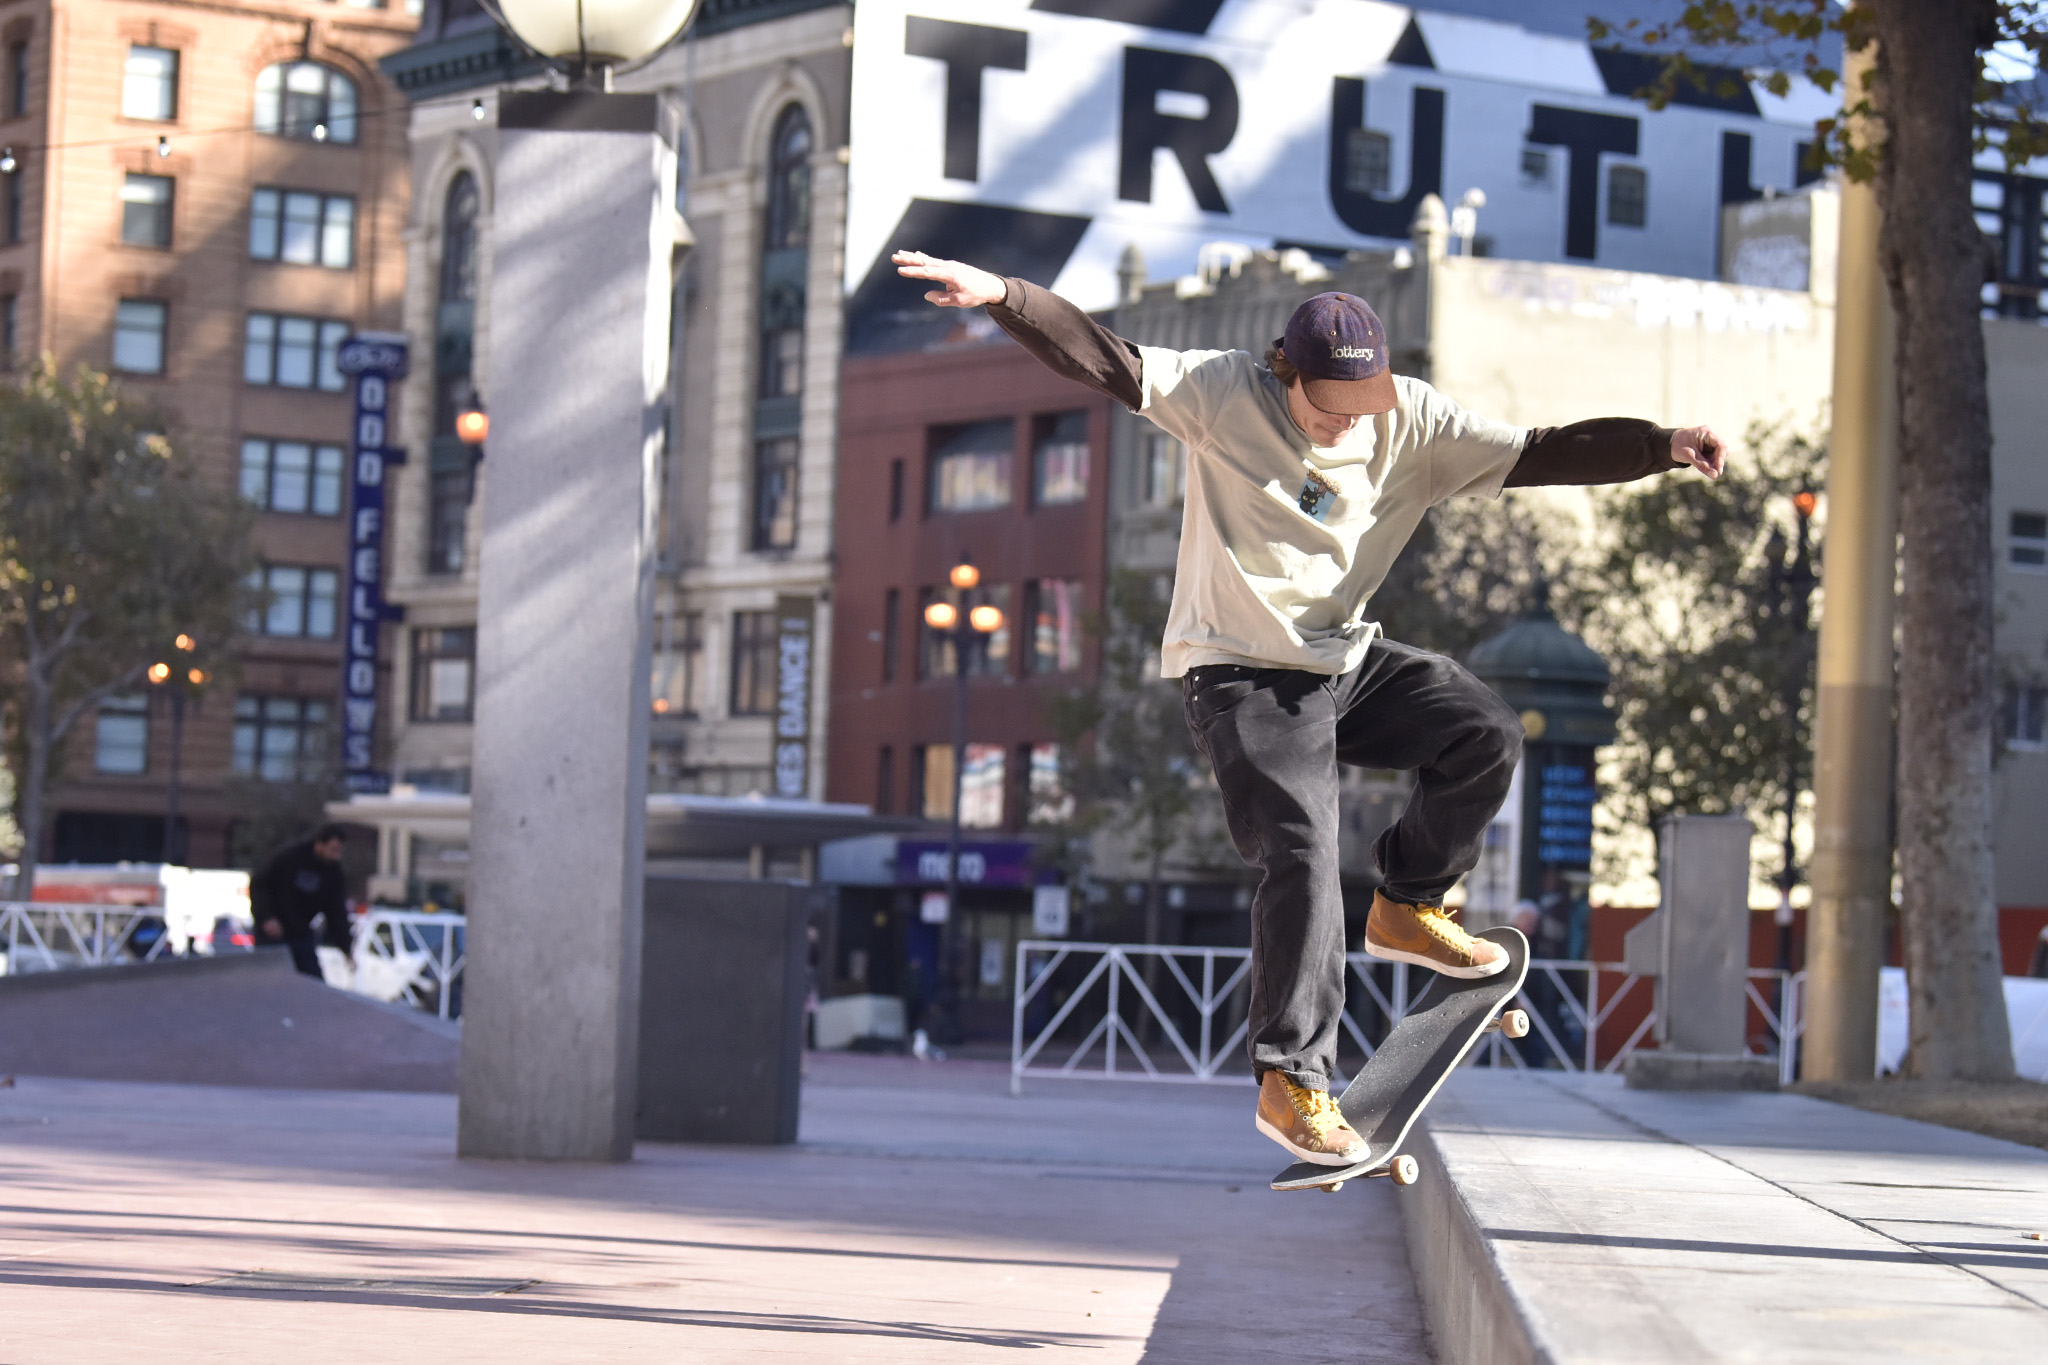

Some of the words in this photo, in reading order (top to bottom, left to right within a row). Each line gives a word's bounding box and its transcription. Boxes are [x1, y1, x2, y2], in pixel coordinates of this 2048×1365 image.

[357, 376, 385, 487] ODD
[346, 507, 381, 769] FELLOWS
[778, 633, 810, 738] DANCE
[918, 852, 986, 881] mero
